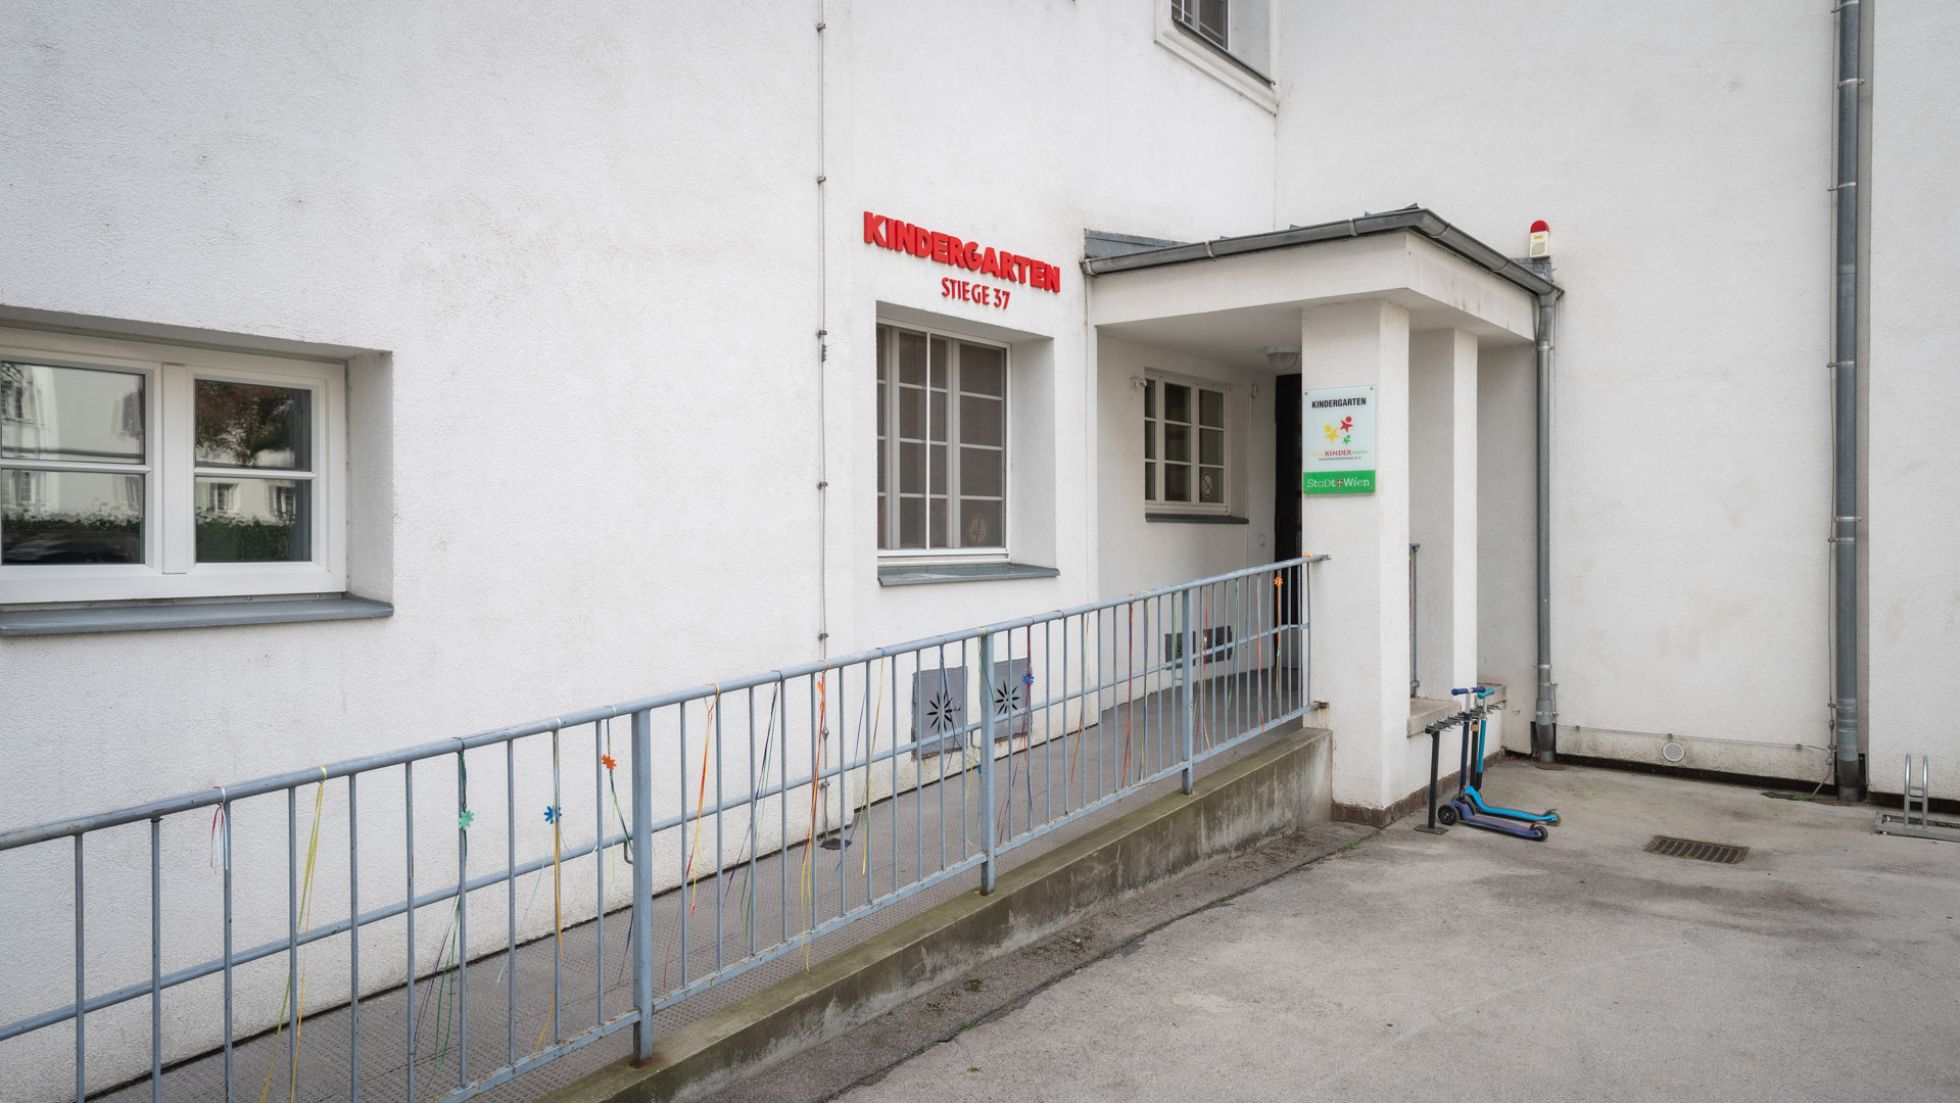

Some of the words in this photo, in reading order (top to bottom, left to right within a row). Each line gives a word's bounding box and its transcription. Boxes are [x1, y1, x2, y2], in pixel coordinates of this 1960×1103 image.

[863, 211, 1061, 293] KINDERGARTEN
[941, 277, 990, 305] STIEGE
[993, 288, 1011, 310] 37
[1312, 397, 1366, 409] KINDERGARTEN
[1343, 477, 1370, 487] Wien
